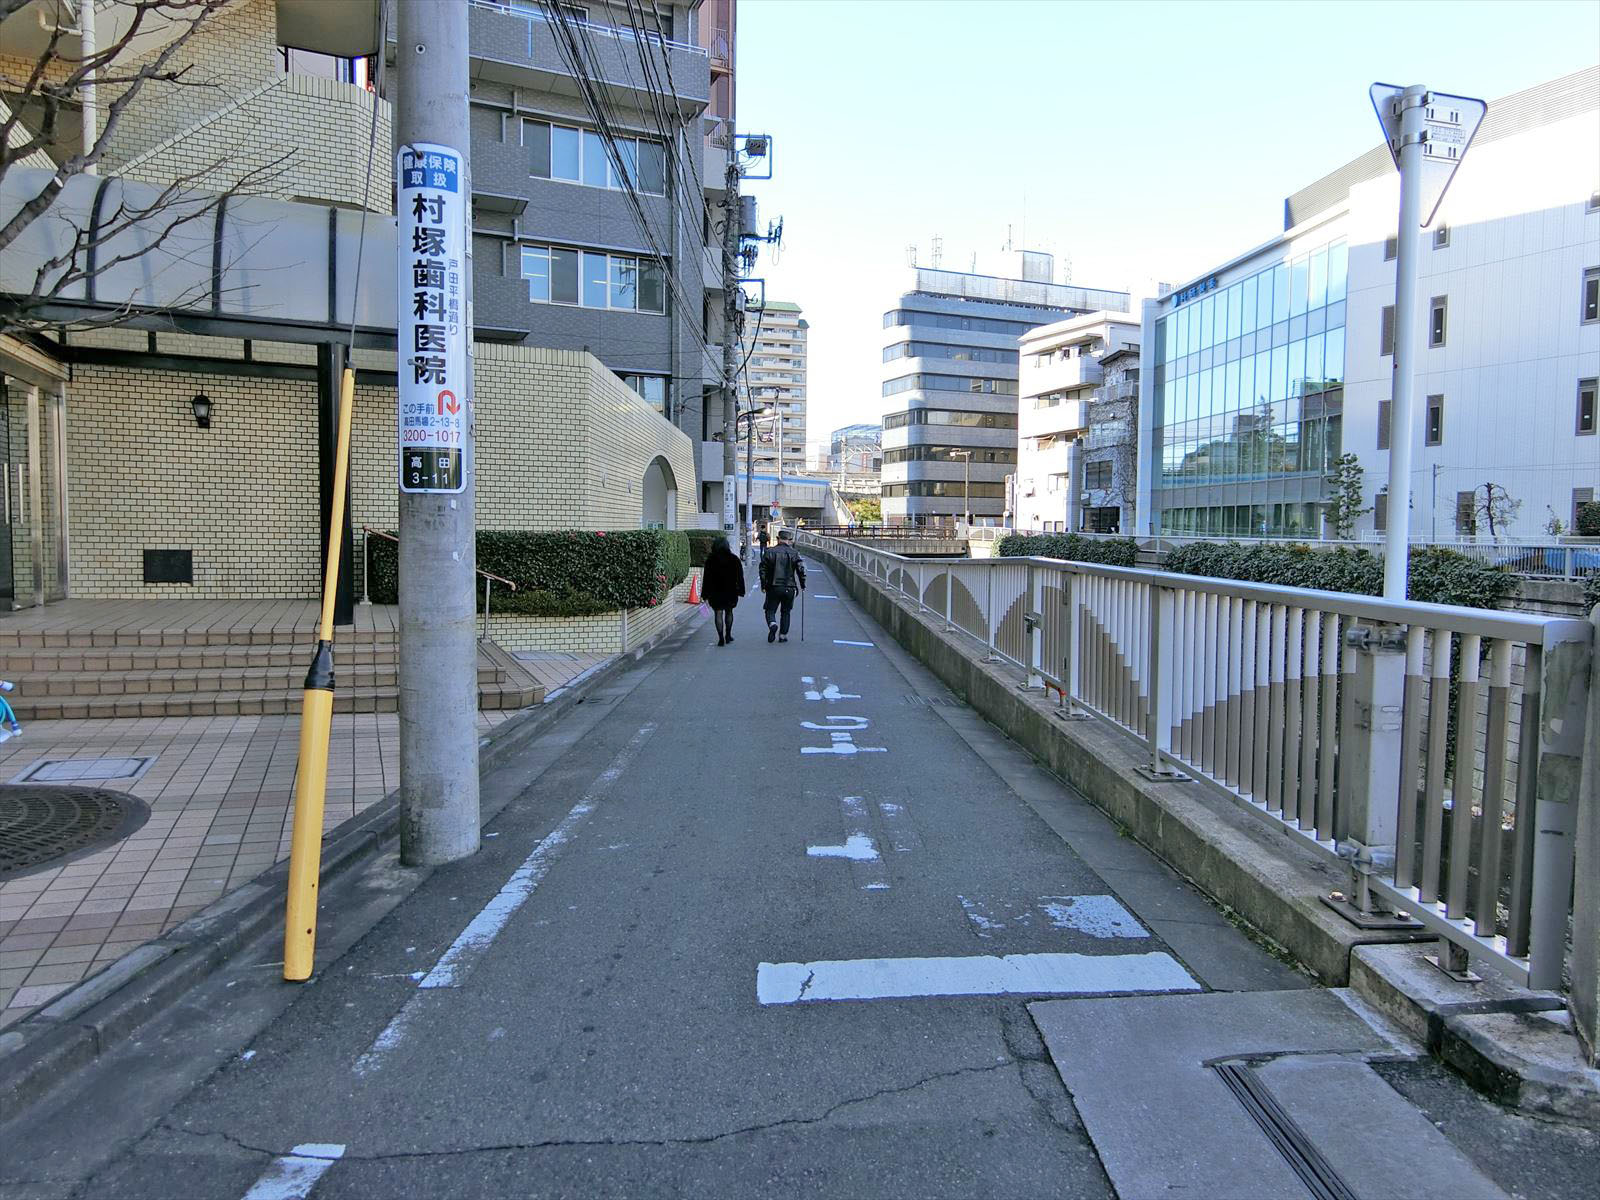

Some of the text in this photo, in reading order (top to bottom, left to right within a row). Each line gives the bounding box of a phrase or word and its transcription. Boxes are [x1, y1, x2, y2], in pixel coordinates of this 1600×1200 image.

[411, 171, 447, 188] 取扱
[412, 193, 447, 384] 村塚歯科医院
[403, 403, 434, 414] この手前
[403, 429, 460, 443] 3200-1017
[411, 456, 450, 468] 高田
[412, 472, 448, 484] 3-11
